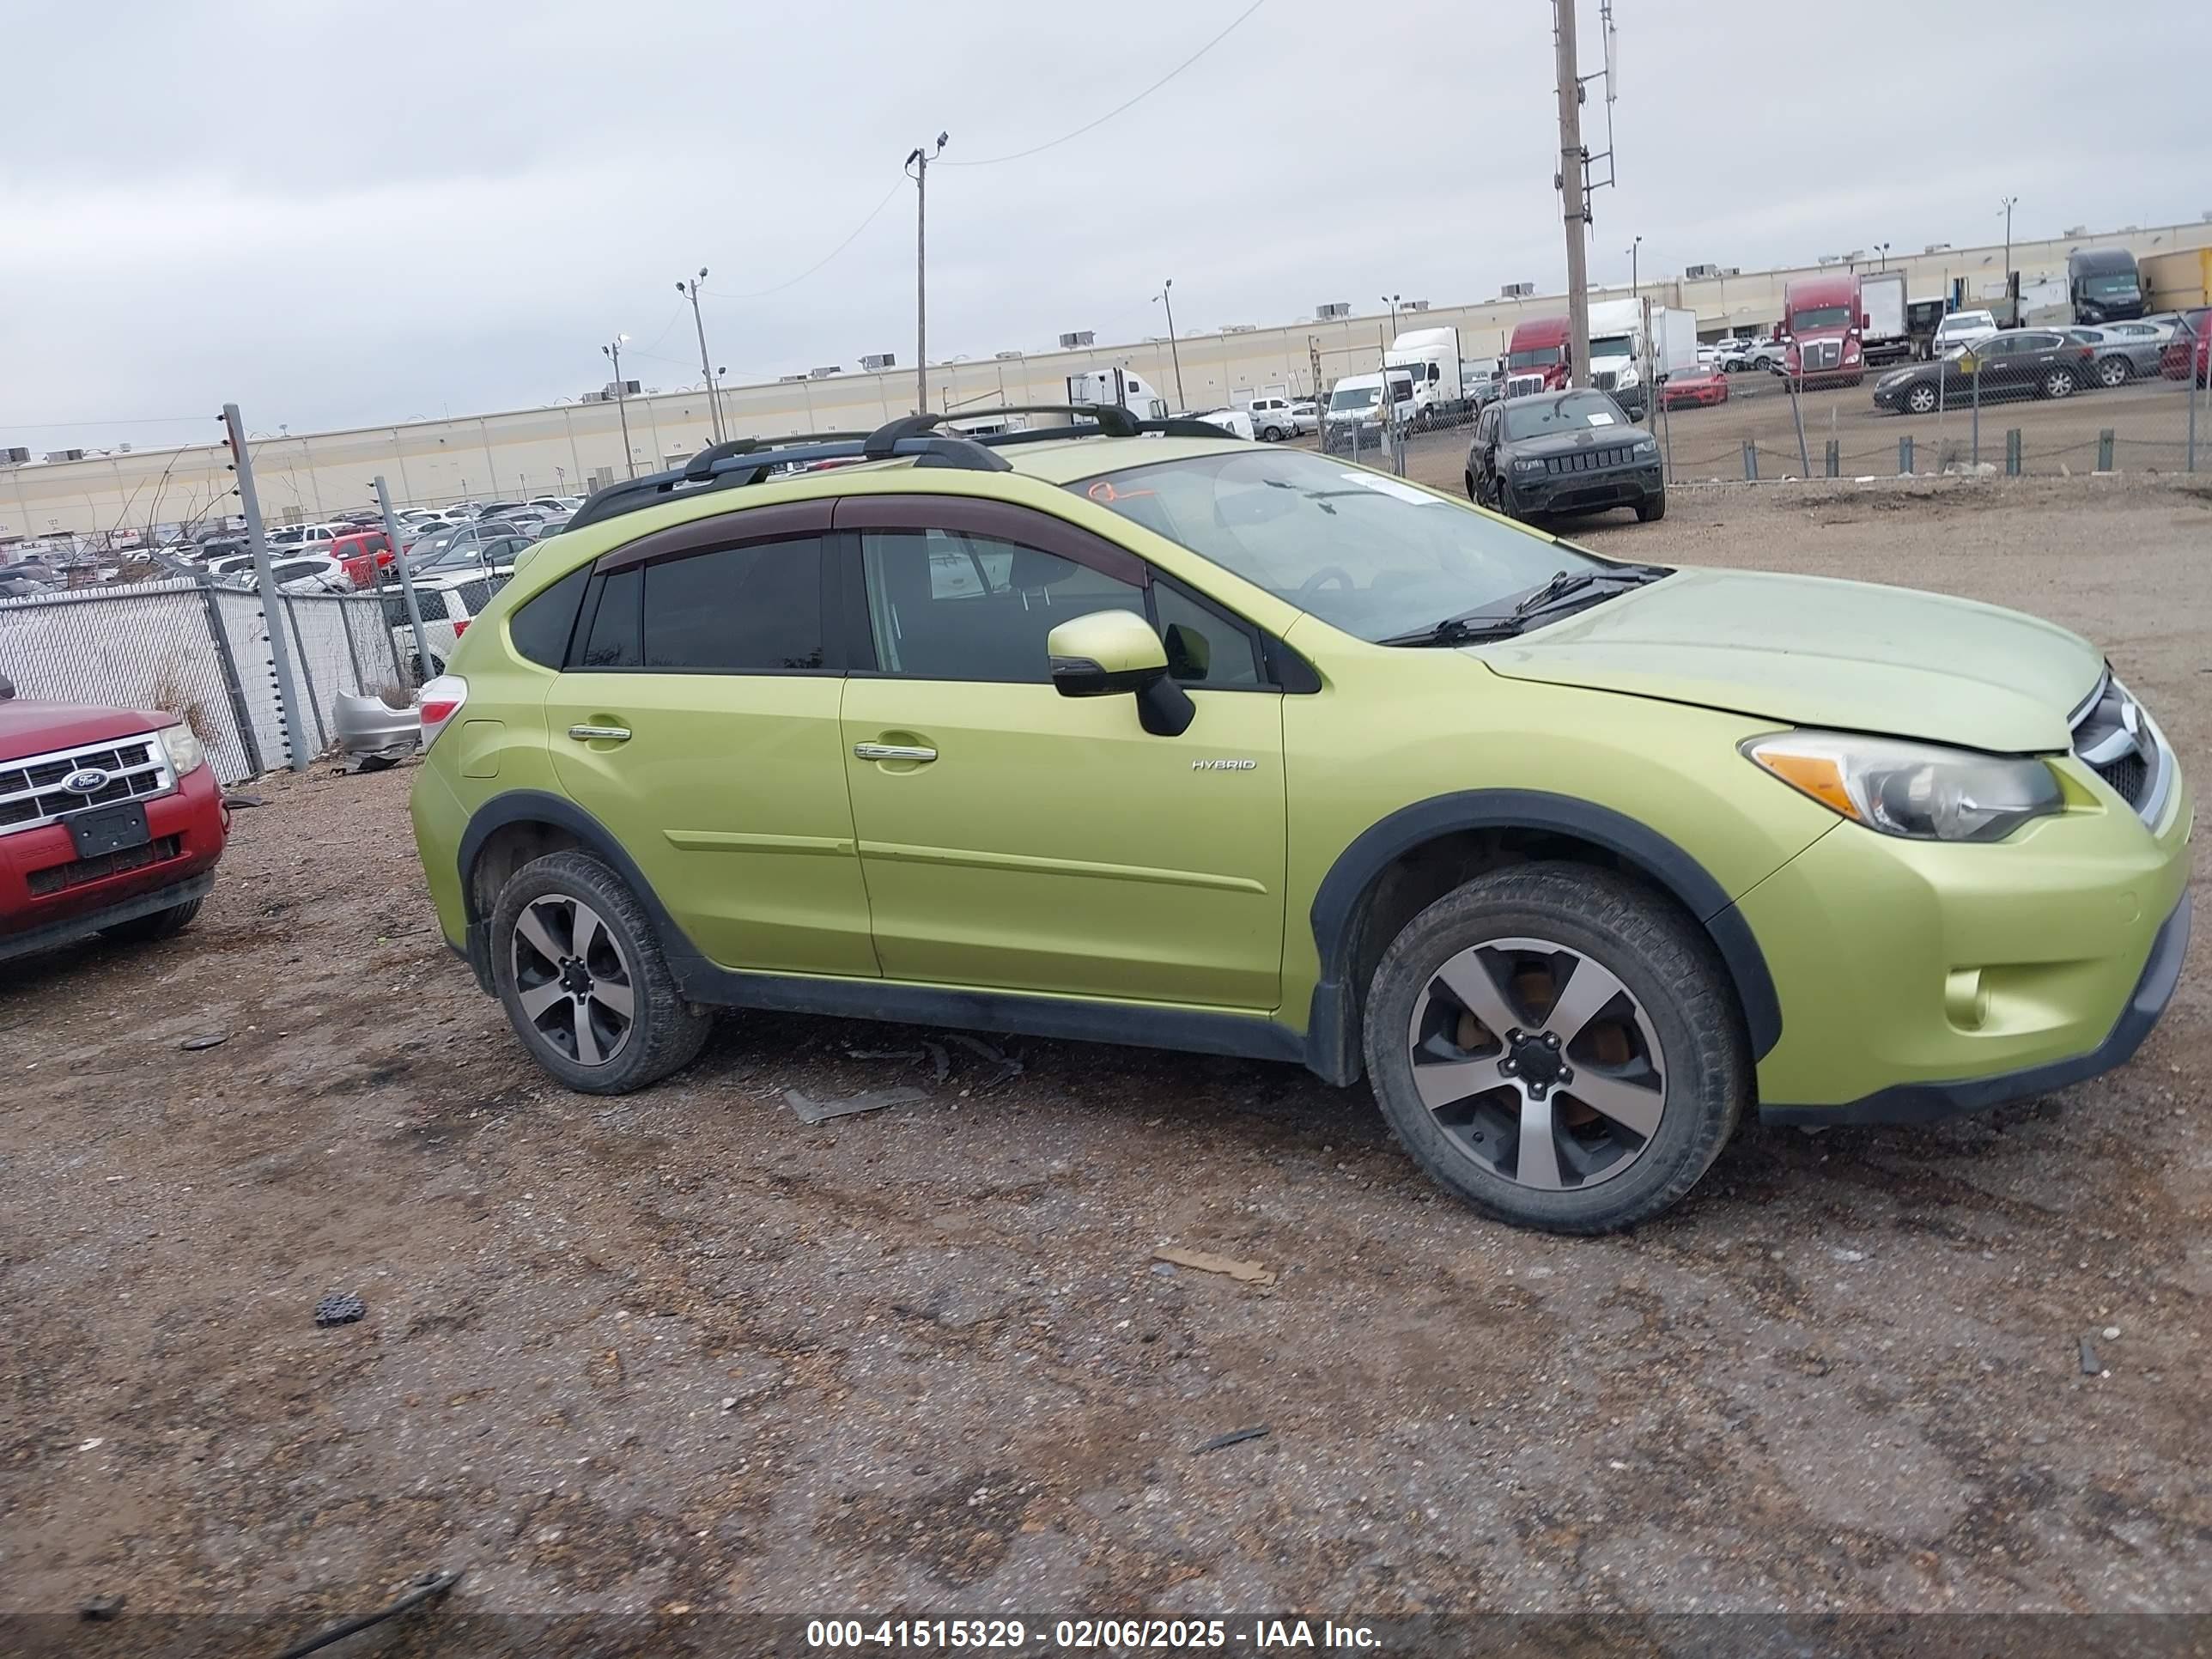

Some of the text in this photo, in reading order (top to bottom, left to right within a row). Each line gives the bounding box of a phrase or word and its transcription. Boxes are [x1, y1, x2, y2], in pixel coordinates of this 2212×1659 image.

[112, 530, 137, 539] FedEx
[1192, 759, 1257, 771] HYBRID
[77, 774, 100, 787] Ford
